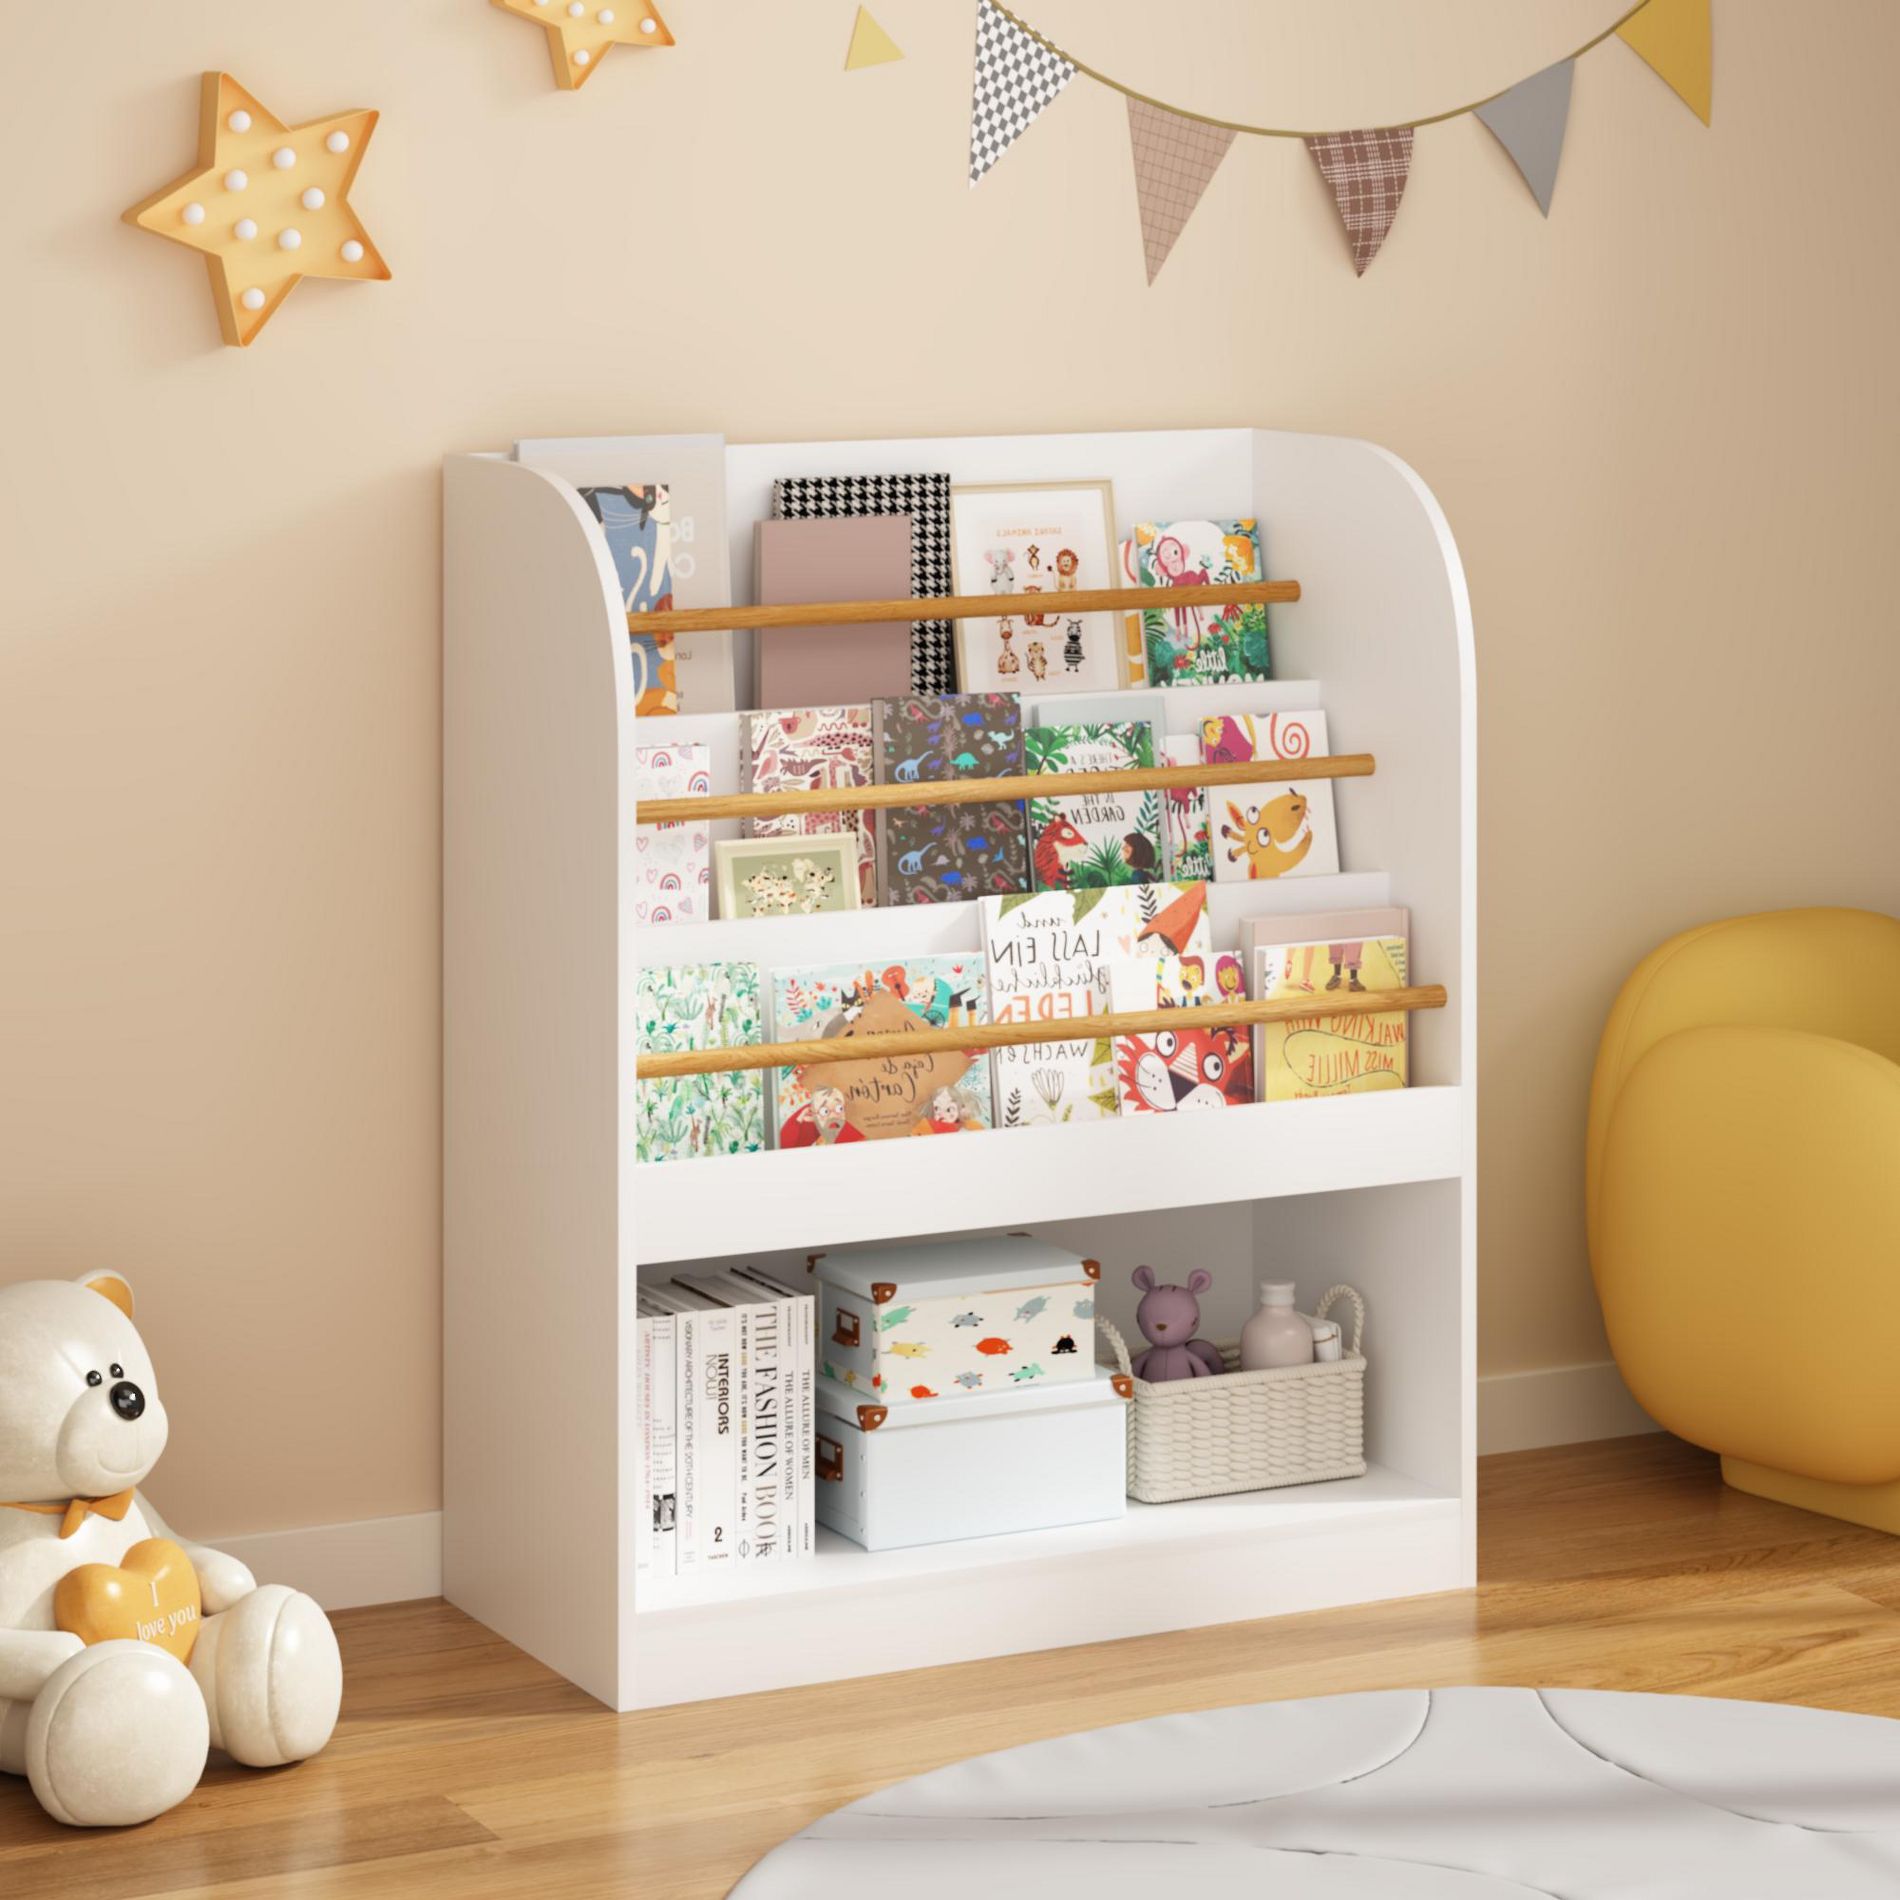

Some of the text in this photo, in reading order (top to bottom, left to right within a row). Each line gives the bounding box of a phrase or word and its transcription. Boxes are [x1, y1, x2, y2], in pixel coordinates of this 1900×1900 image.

[718, 1353, 730, 1435] INTERIORS
[755, 1305, 777, 1558] THE FASHION BOOK
[785, 1370, 794, 1500] THE ALLURE OF WOMEN
[801, 1369, 810, 1480] THE ALLURE OF MEN
[714, 1526, 723, 1542] 2
[136, 1604, 198, 1641] love you
[149, 1580, 160, 1607] I
